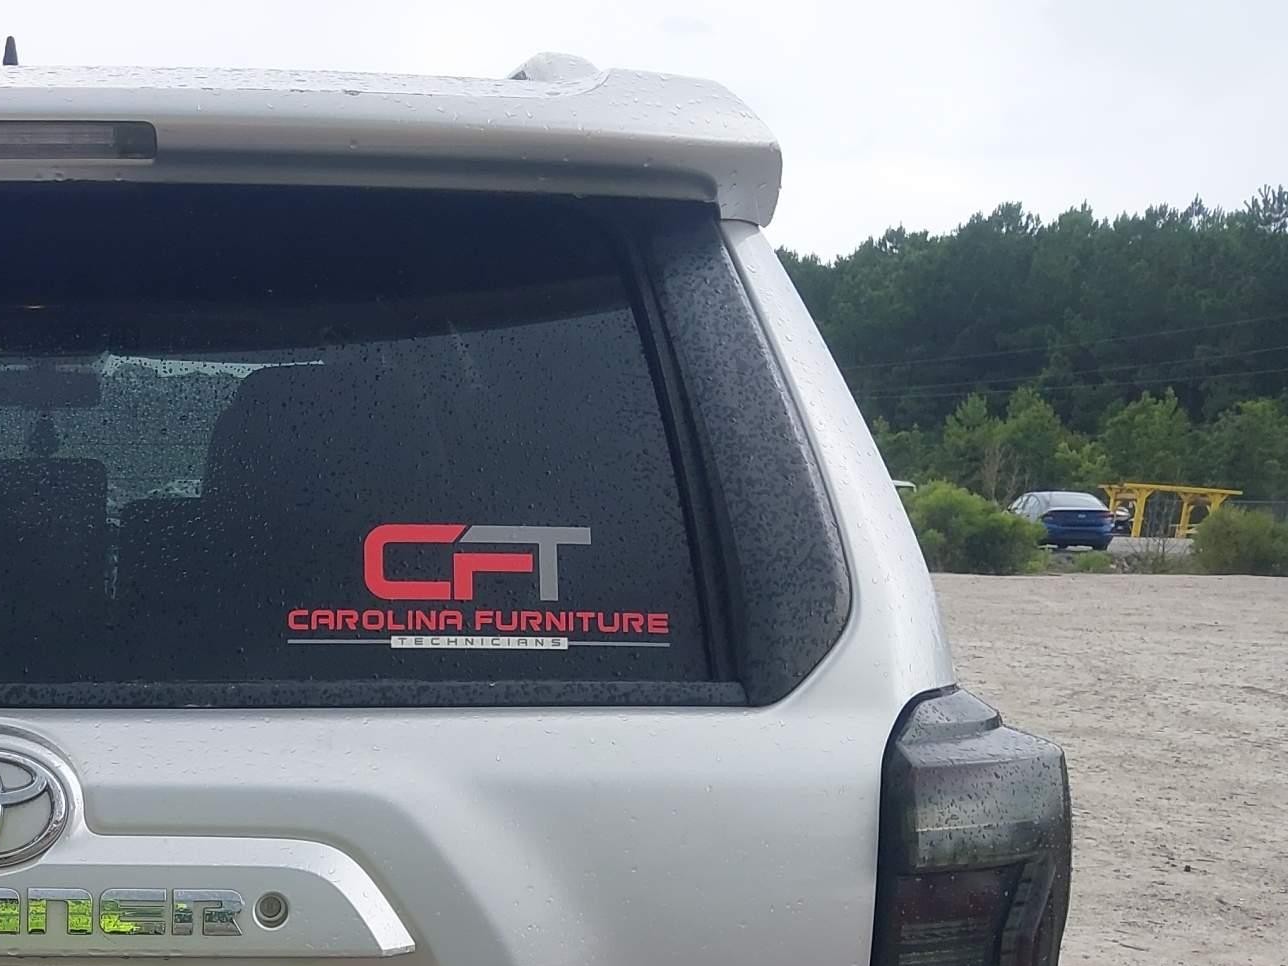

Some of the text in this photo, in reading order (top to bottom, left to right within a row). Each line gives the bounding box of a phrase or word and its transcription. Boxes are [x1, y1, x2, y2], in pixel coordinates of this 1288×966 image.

[363, 523, 592, 601] CFT
[287, 609, 669, 634] CAROLINA FURNITURE
[397, 636, 563, 648] TECHNICIANS
